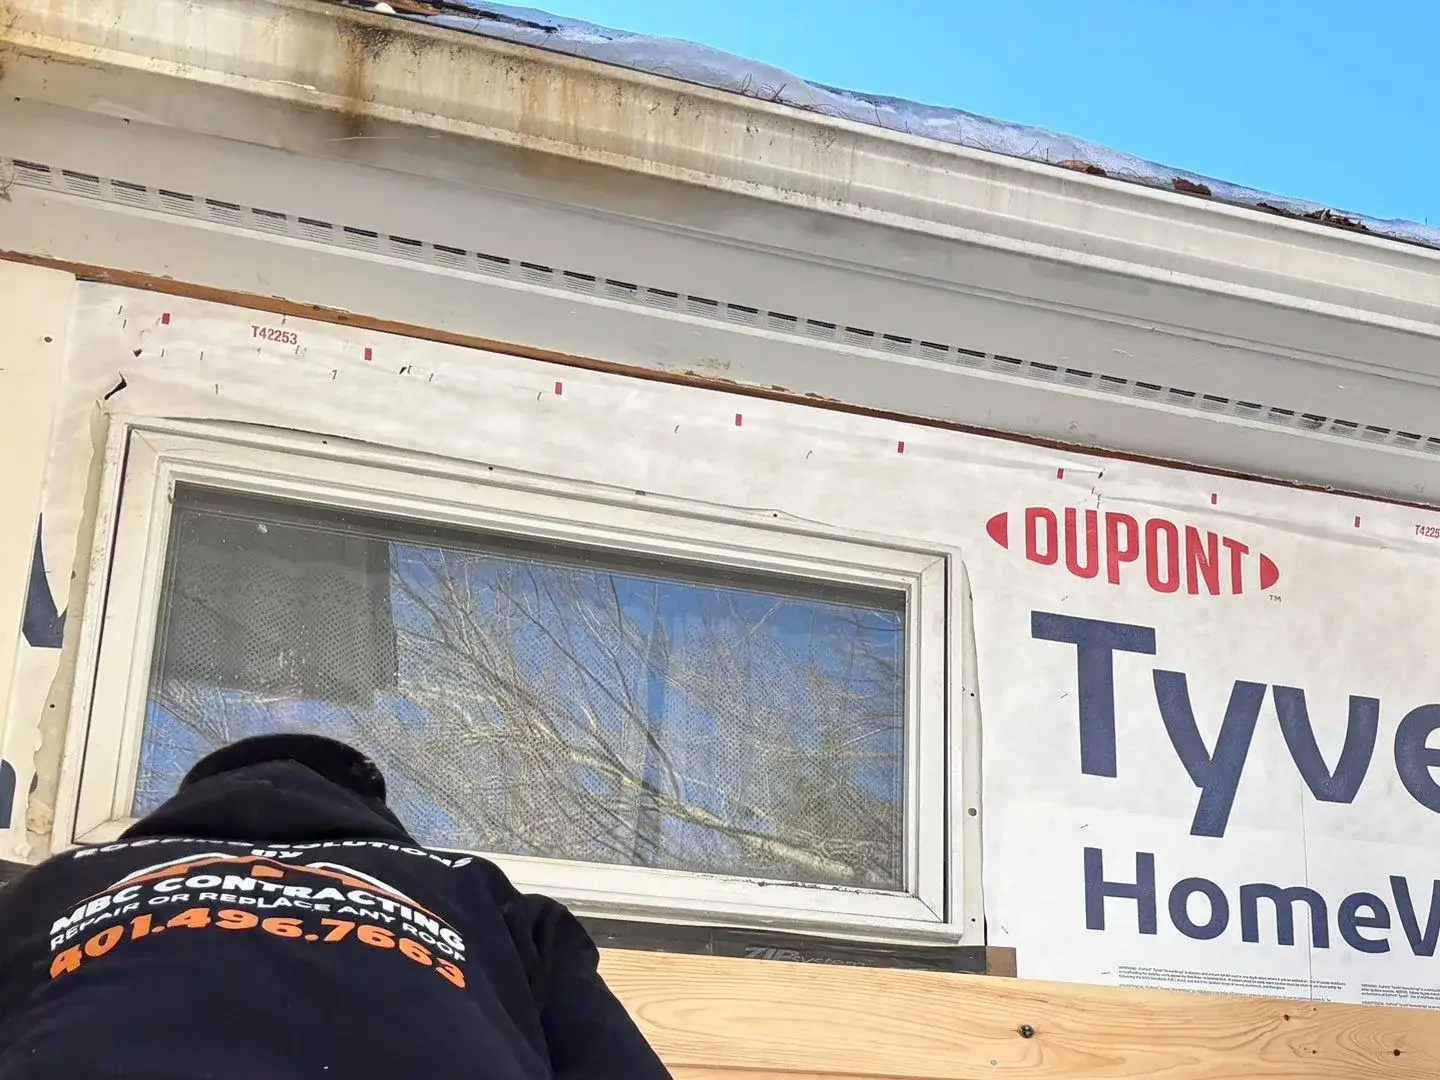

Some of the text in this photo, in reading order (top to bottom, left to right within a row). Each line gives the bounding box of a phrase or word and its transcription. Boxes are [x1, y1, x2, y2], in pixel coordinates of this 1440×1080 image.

[251, 325, 298, 345] T42253
[1025, 507, 1249, 596] DUPONT
[50, 874, 466, 951] MBC CONTRACTING
[50, 902, 140, 950] REPAIR
[148, 891, 190, 905] OR
[198, 891, 331, 912] REPLACE
[337, 905, 396, 923] ANY
[50, 907, 466, 988] 401.496.7663
